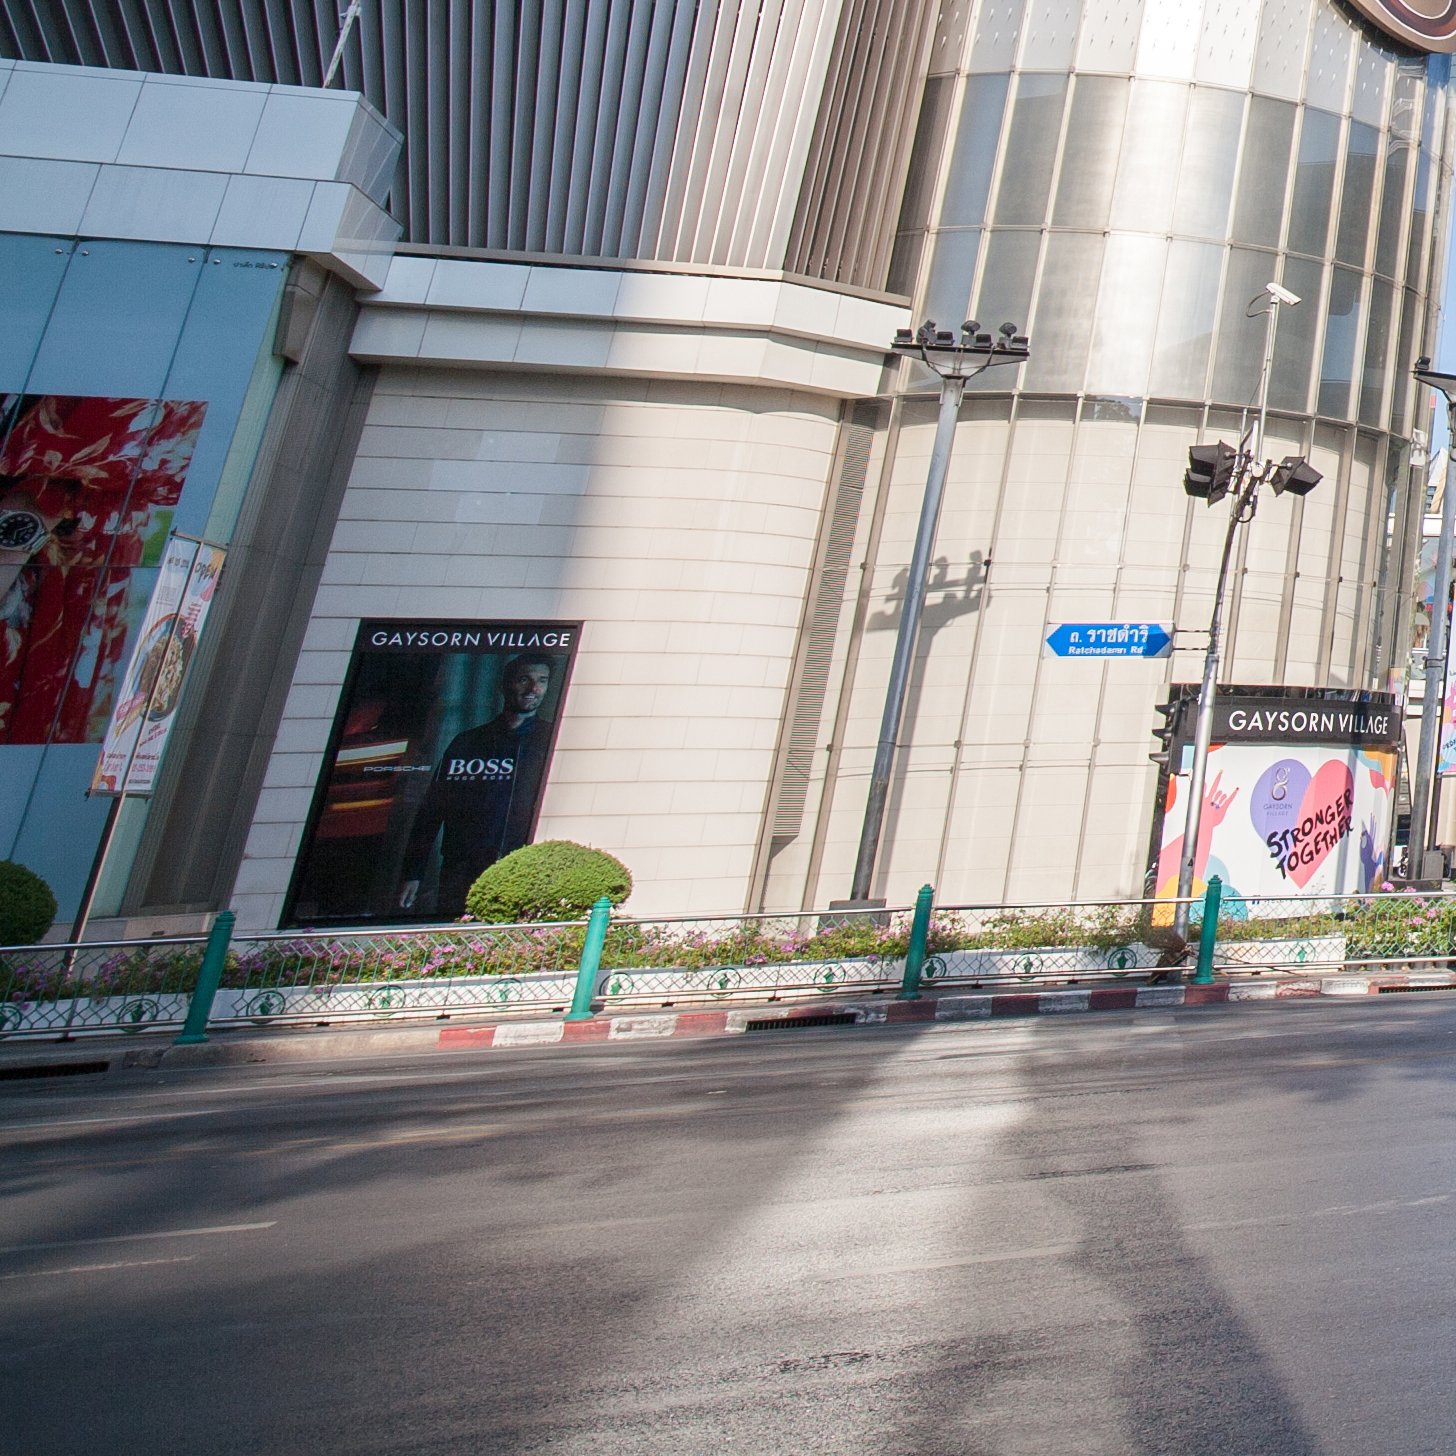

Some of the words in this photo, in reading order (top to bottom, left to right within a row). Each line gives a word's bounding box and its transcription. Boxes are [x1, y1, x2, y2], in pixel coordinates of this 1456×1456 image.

[371, 631, 481, 646] GAYSORN
[487, 632, 571, 647] VILLAGE
[1229, 710, 1335, 732] GAYSORN
[1338, 714, 1389, 736] VILLAGE
[363, 765, 433, 773] PORSCHE
[447, 758, 515, 776] BOSS
[1263, 803, 1293, 811] GAYSORN
[1267, 788, 1354, 860] STRONGER
[1275, 815, 1354, 881] TOGETHER
